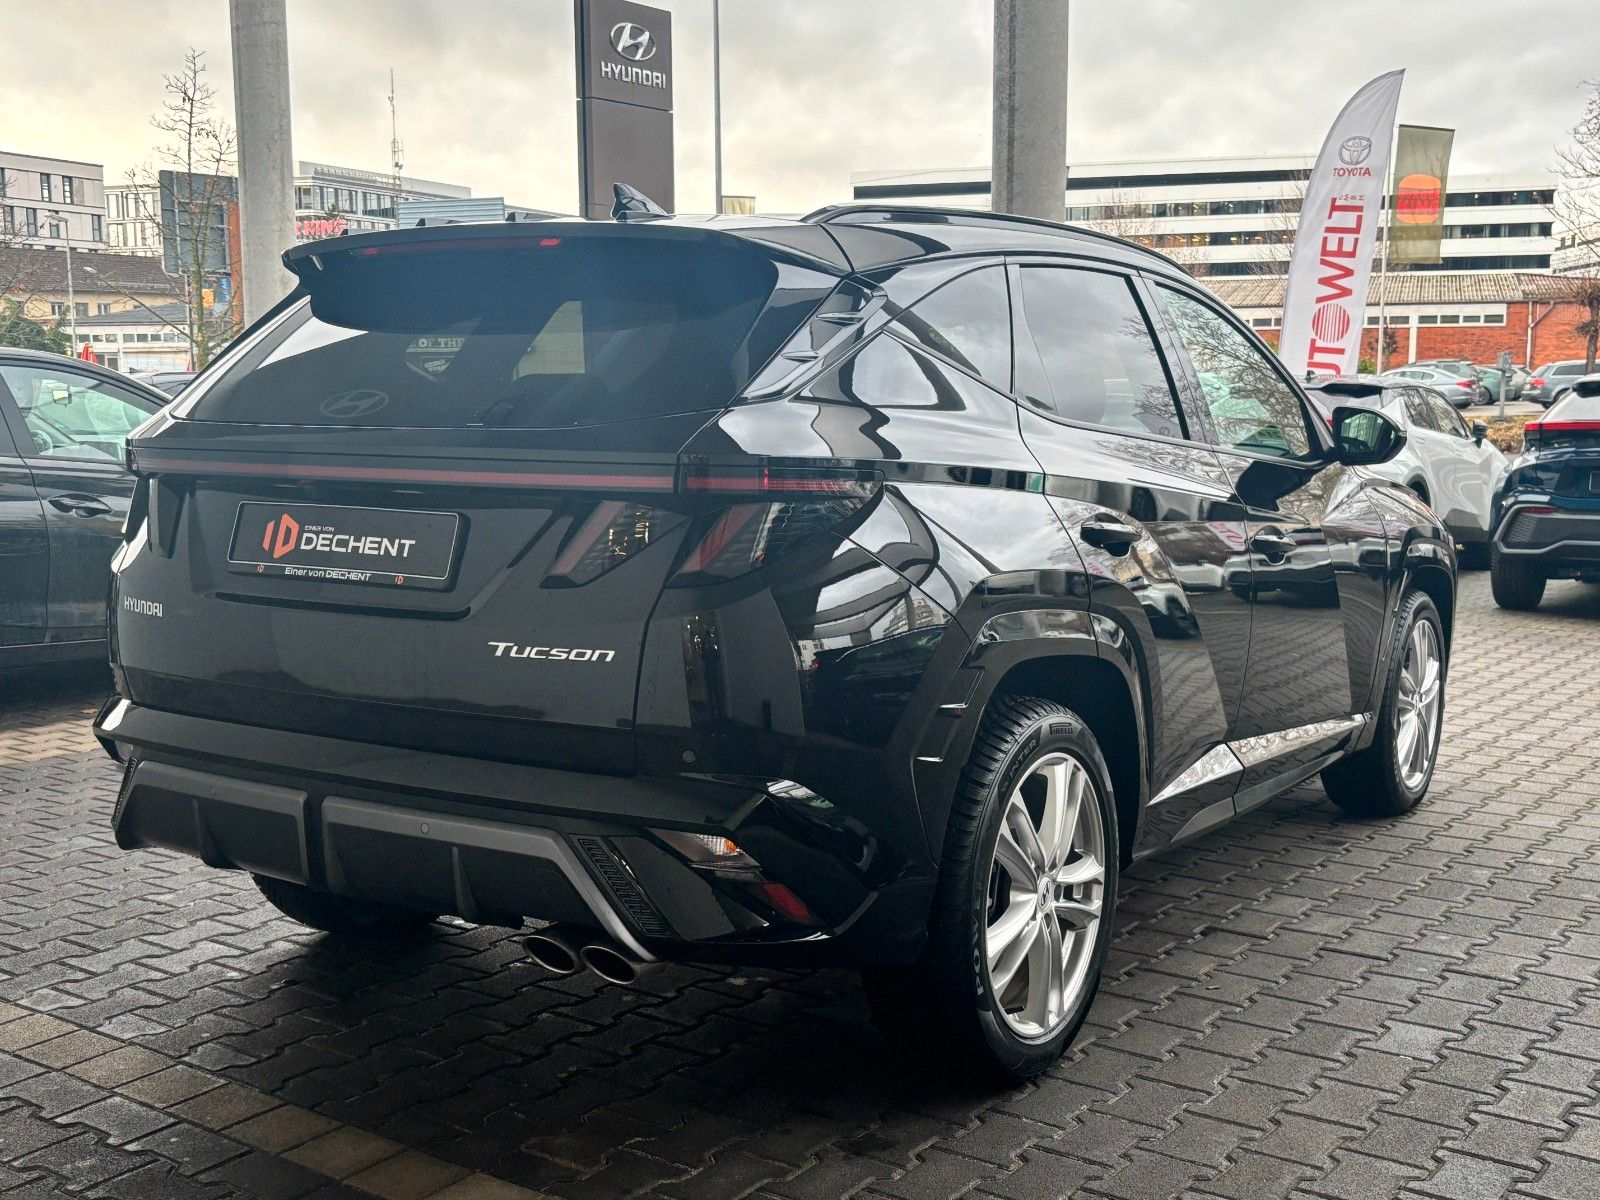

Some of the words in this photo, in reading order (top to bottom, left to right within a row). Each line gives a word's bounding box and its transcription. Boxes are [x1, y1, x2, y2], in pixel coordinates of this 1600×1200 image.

[601, 61, 666, 89] HYUNDAI
[1332, 167, 1372, 178] TOYOTA
[300, 532, 416, 558] DECHENT
[285, 566, 307, 576] Einer
[308, 570, 325, 578] von
[325, 570, 372, 582] DECHENT
[124, 595, 163, 618] HYUNDAI
[1049, 721, 1074, 736] PIRELLI
